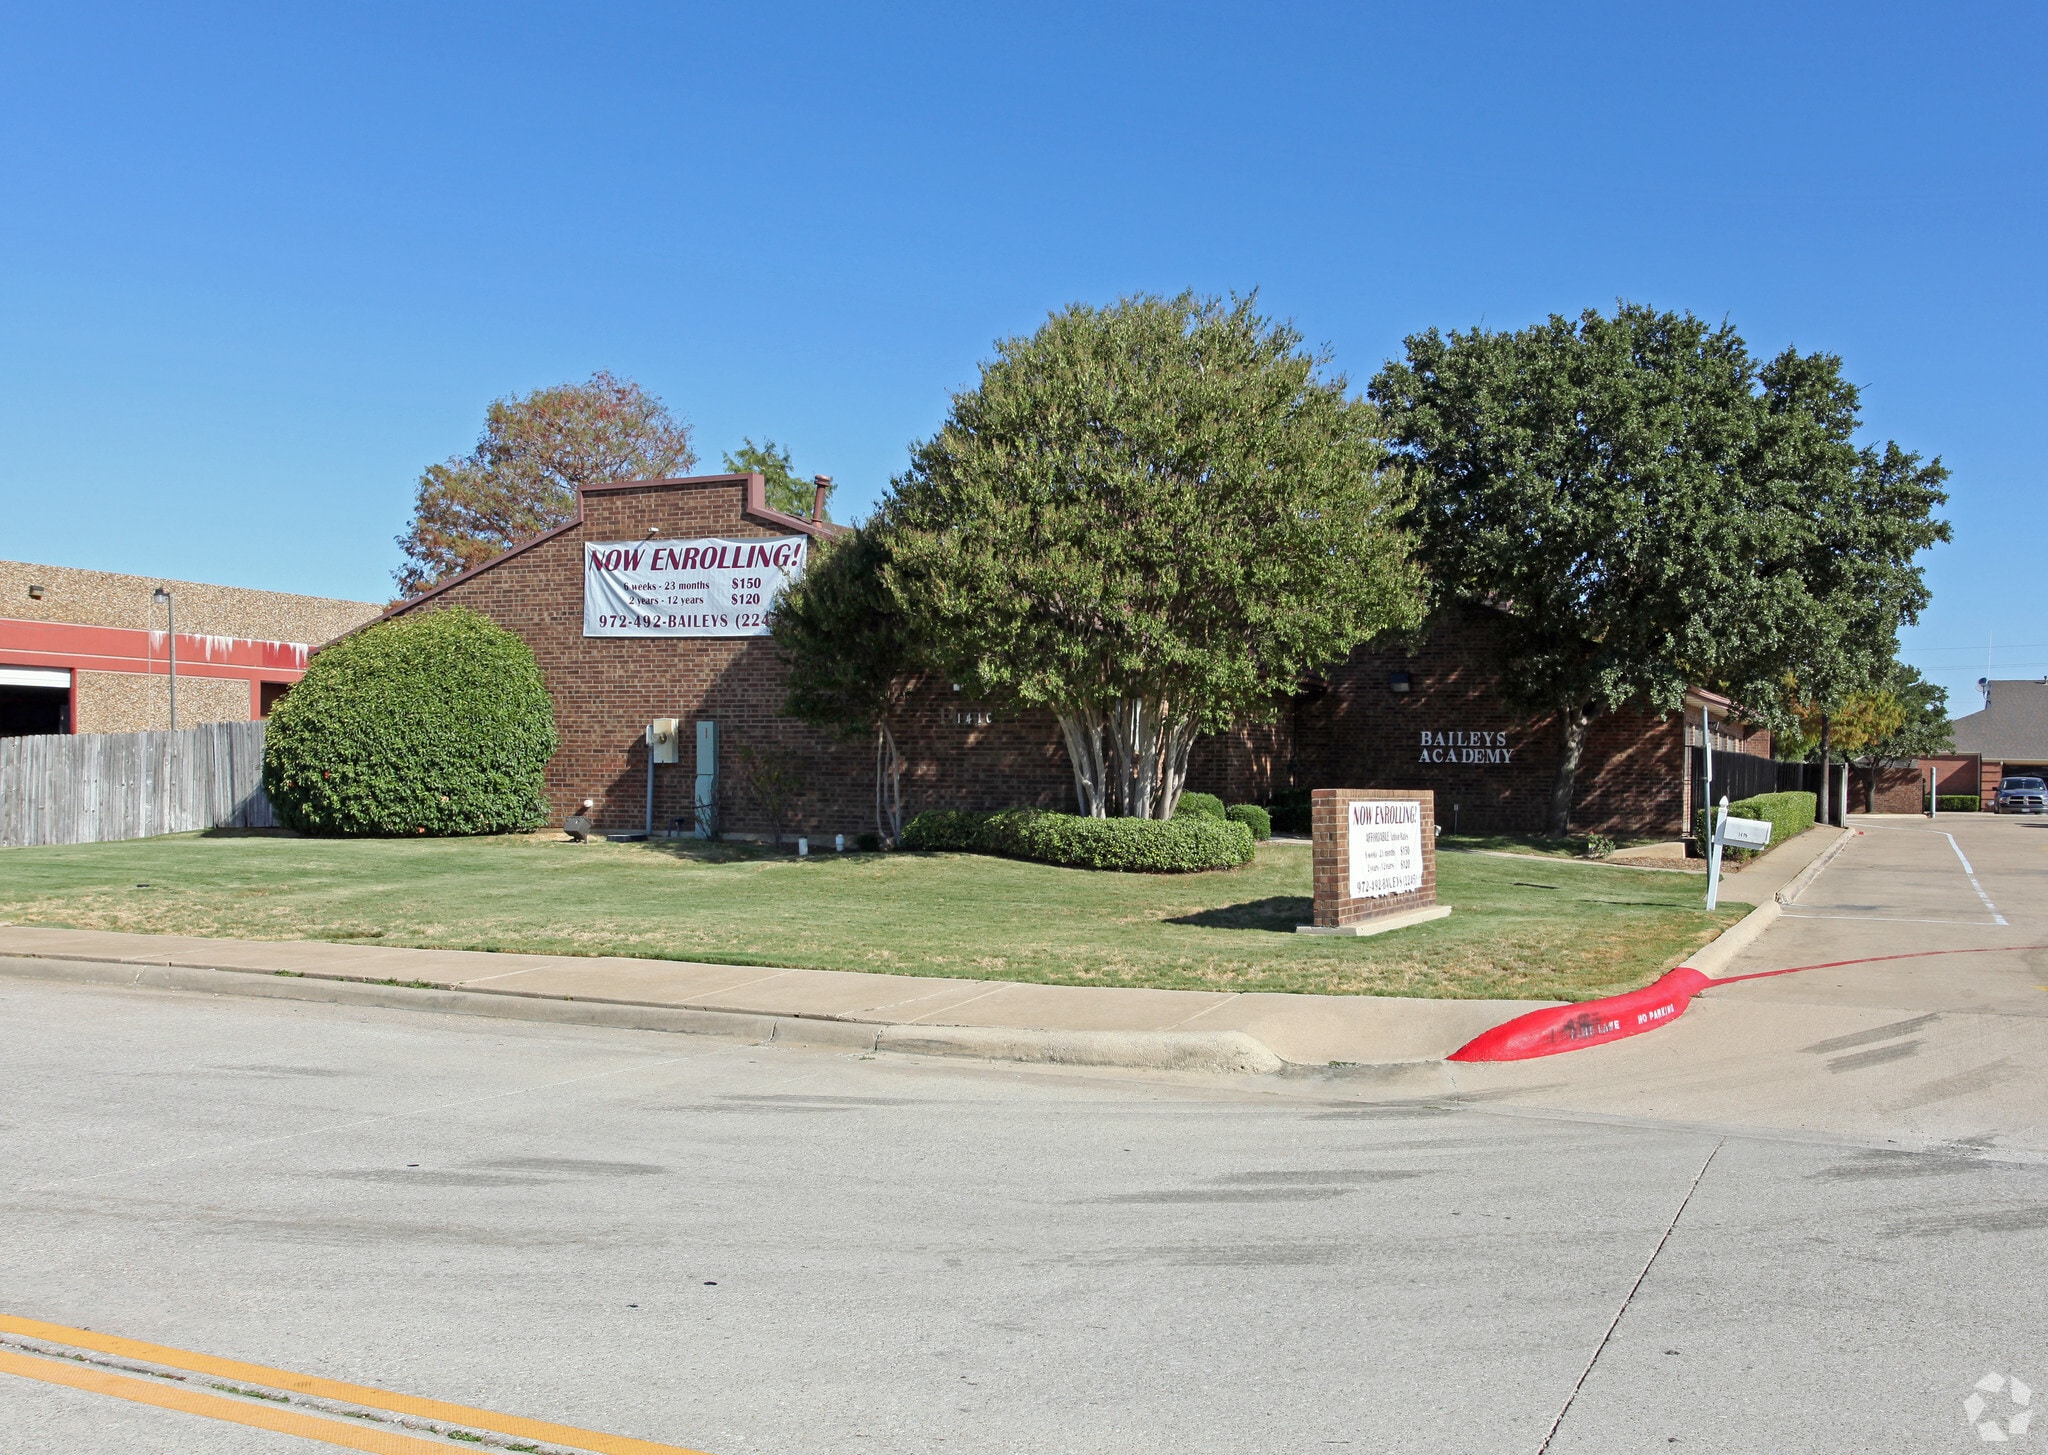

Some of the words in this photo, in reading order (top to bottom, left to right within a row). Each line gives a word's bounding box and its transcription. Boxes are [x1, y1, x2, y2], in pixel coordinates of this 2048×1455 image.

[589, 549, 645, 571] NOW
[650, 544, 801, 570] ENROLLING!
[623, 582, 629, 591] 6
[632, 582, 656, 591] weeks
[664, 581, 676, 590] 23
[679, 581, 710, 590] months
[732, 577, 761, 589] $150
[629, 596, 635, 605] 2
[637, 598, 659, 606] years
[668, 596, 678, 604] 12
[681, 597, 704, 606] years
[731, 593, 760, 605] $120
[599, 614, 728, 628] 972-492-BAILEYS
[735, 613, 770, 630] (224
[1420, 731, 1506, 746] BAILEYS
[1418, 748, 1513, 763] ACADEMY
[1353, 805, 1372, 826] NOW
[1375, 805, 1418, 825] ENROLLING!
[1637, 1014, 1648, 1024] NO
[1649, 1004, 1675, 1021] PARKING
[1597, 1019, 1620, 1034] LANE
